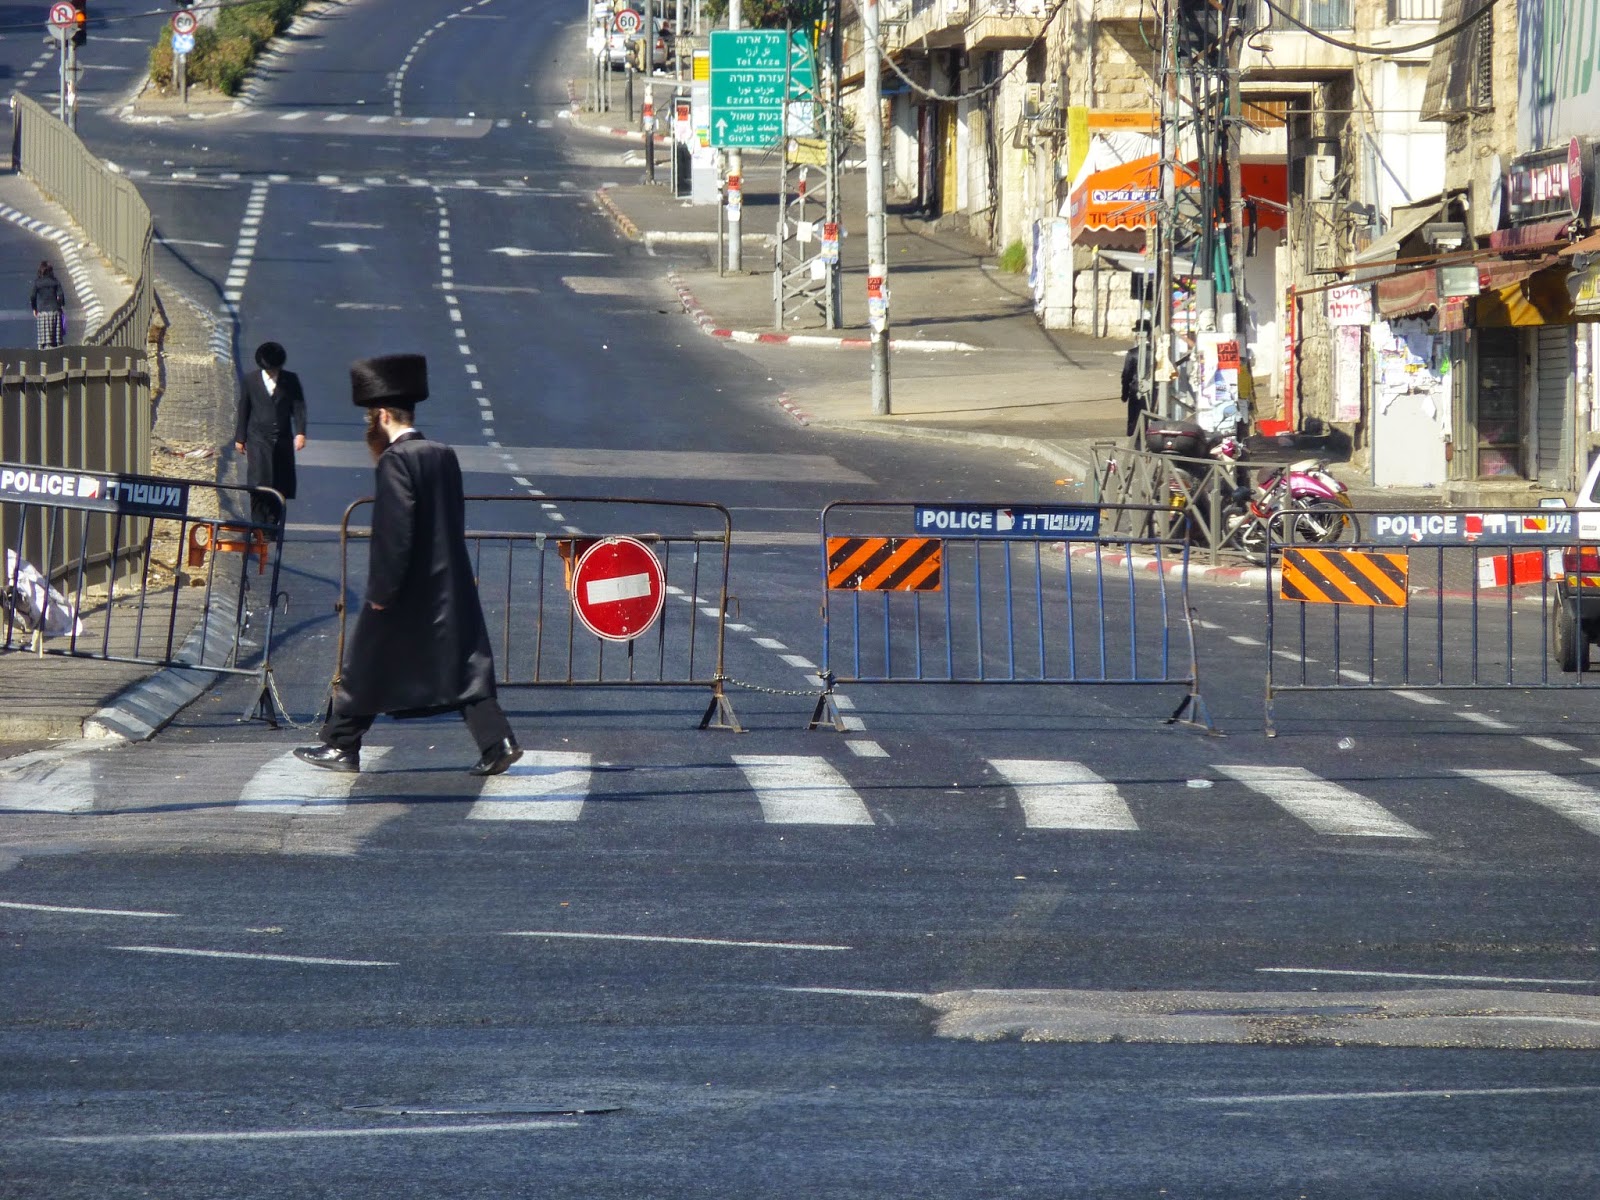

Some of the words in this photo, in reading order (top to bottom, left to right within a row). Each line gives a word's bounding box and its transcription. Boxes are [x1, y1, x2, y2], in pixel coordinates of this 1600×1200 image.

[620, 16, 635, 27] 60
[736, 35, 761, 44] ארזה
[765, 34, 780, 44] תל
[736, 57, 751, 66] Tel
[756, 57, 780, 66] Arza
[729, 74, 754, 83] תורה
[758, 74, 784, 83] עזרת
[726, 96, 754, 104] Ezrat
[730, 111, 755, 121] שאול
[728, 134, 755, 142] Giv'at
[1, 470, 75, 496] POLICE
[105, 480, 182, 507] משטרה
[922, 510, 993, 529] POLICE
[1022, 513, 1094, 531] משטרה
[1377, 515, 1457, 535] POLICE
